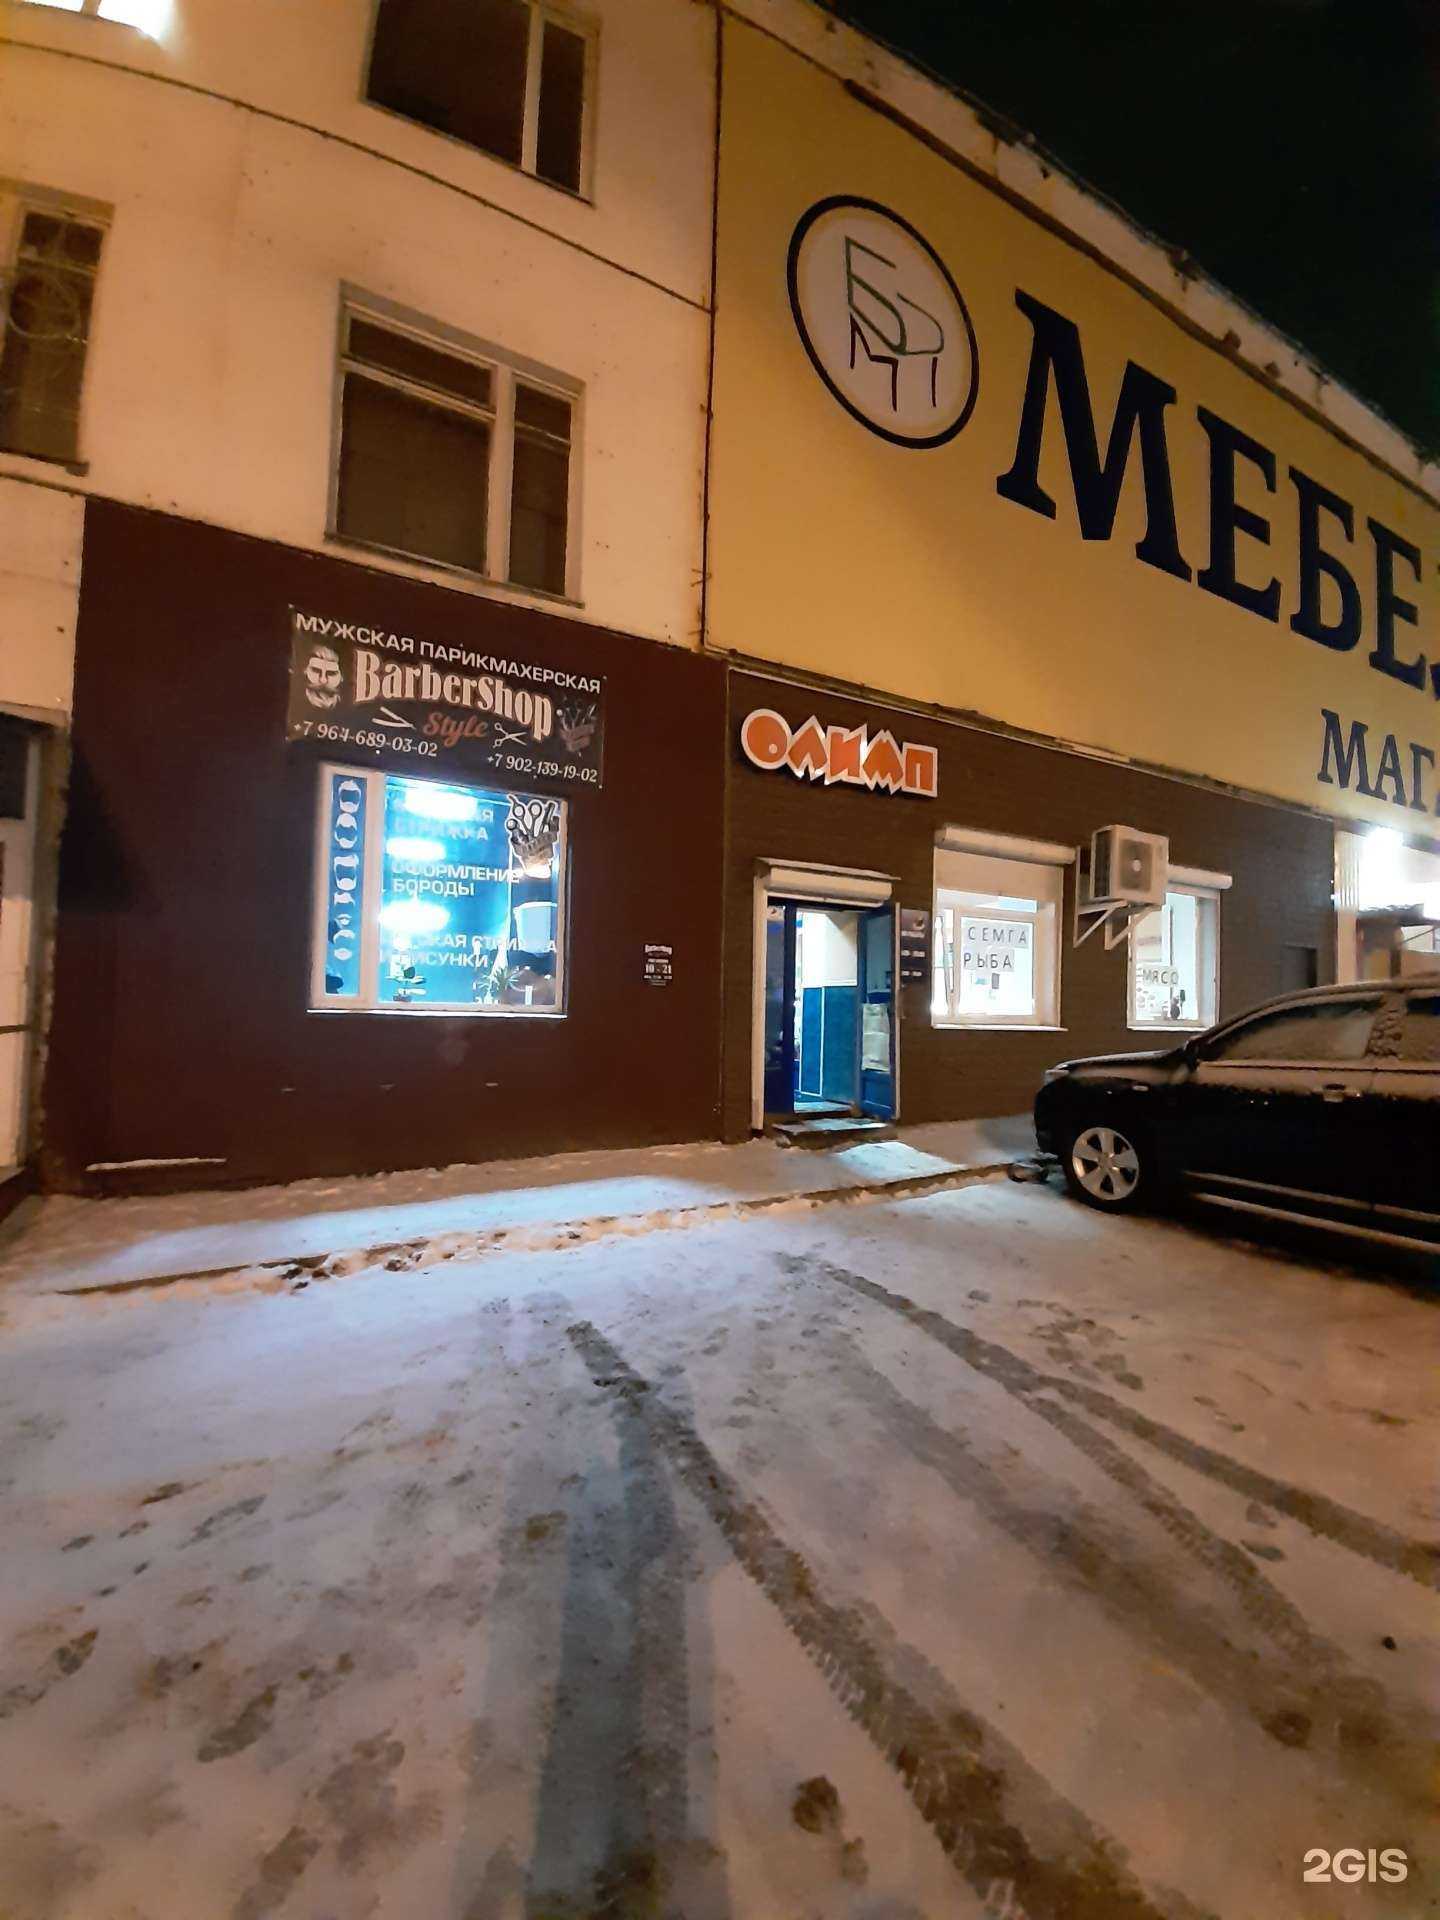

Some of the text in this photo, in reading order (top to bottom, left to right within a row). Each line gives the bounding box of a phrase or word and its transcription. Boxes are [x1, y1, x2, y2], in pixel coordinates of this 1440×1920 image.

[997, 287, 1440, 702] МЕБЕ
[295, 612, 601, 694] МУЖСКАЯ ПАРИКМАХЕРСКАЯ
[293, 720, 438, 757] +7 964-689-03-02
[422, 711, 489, 748] Style
[487, 753, 598, 782] +7 902-139-19-02
[742, 709, 938, 797] ОЛИМП
[1317, 708, 1440, 817] МАГ
[393, 878, 475, 898] БОРОДЫ
[967, 926, 1027, 943] СЕМГА
[963, 952, 1013, 969] РЫБА
